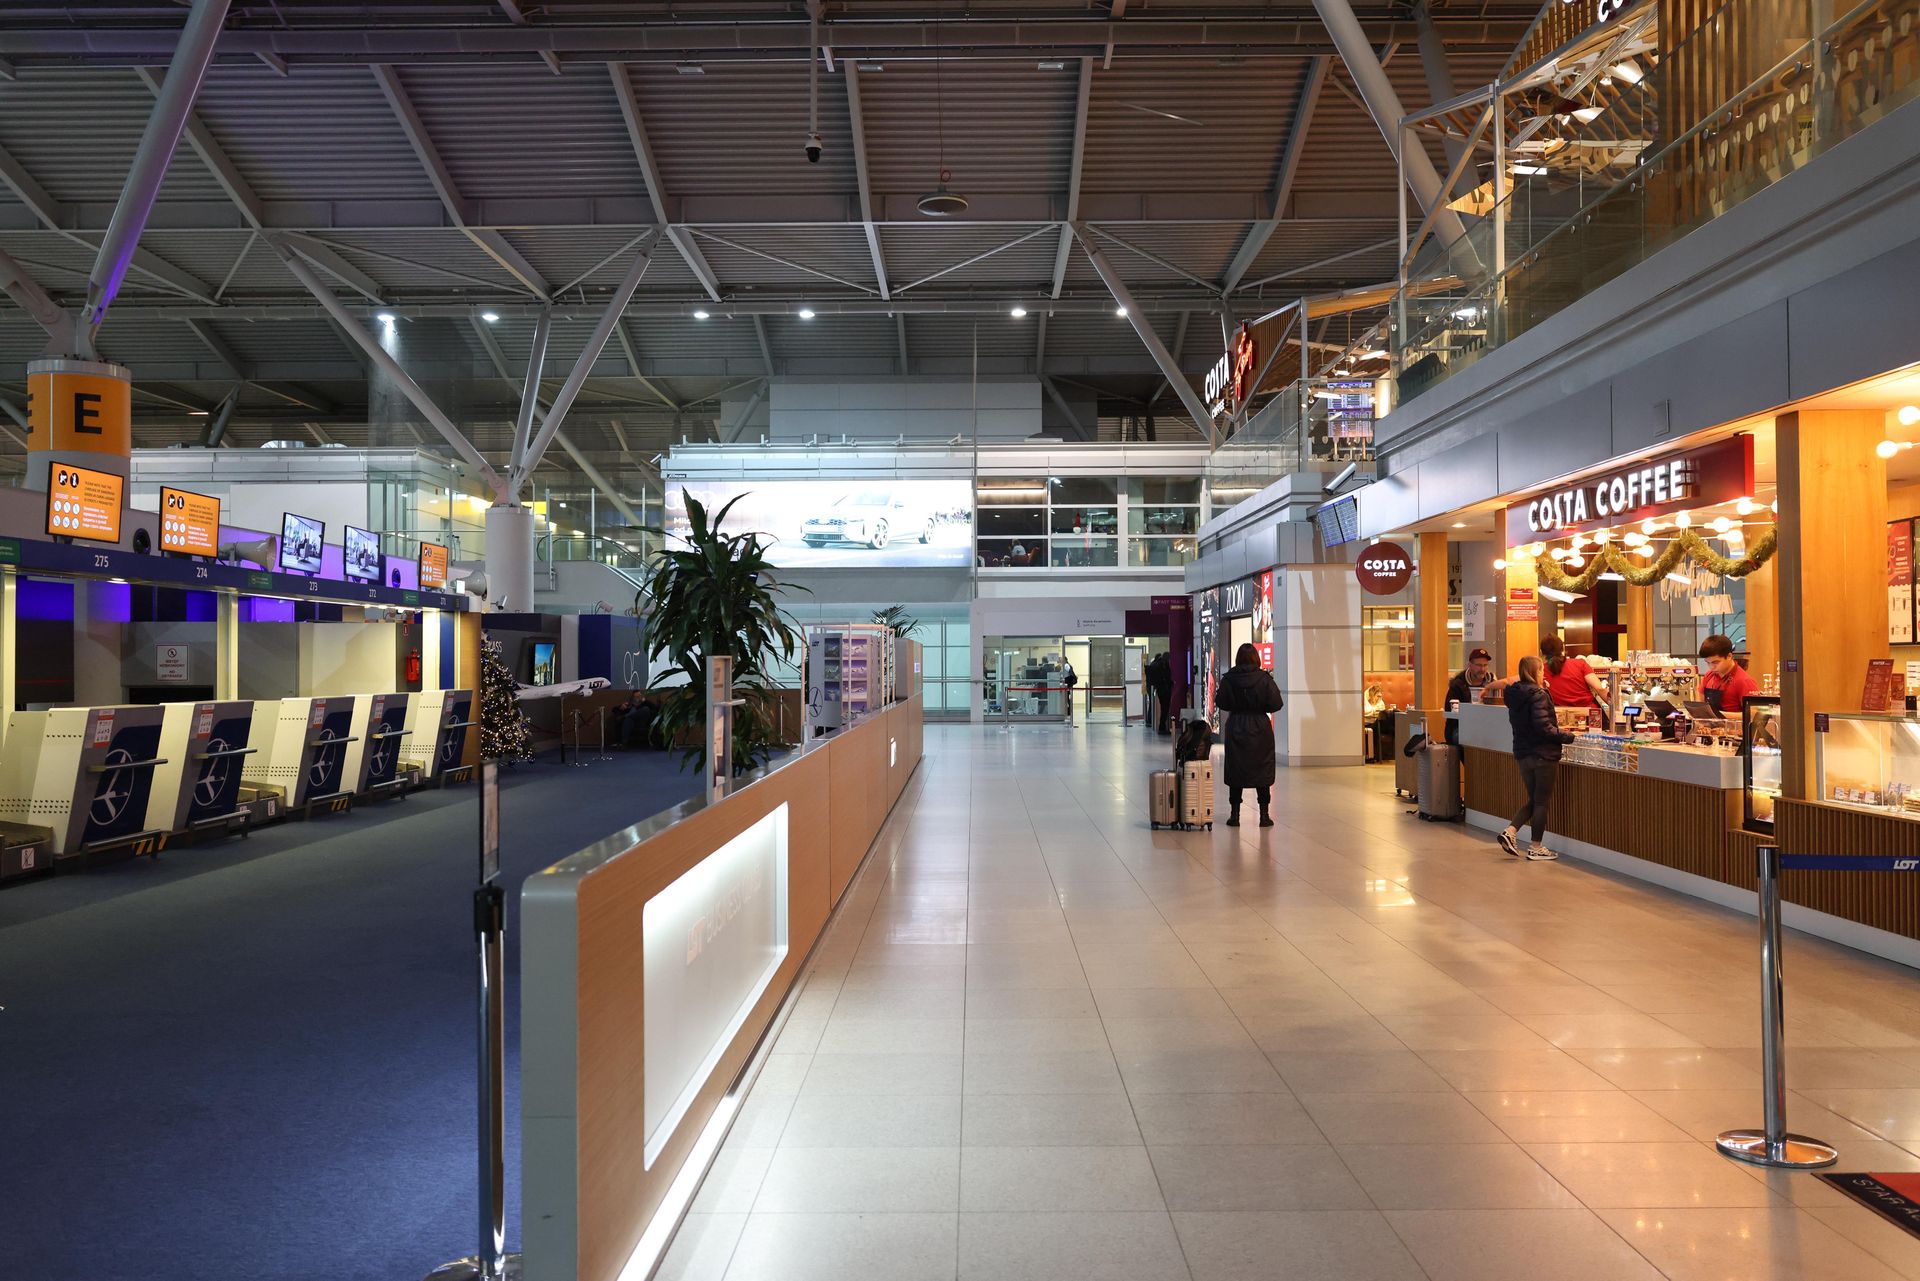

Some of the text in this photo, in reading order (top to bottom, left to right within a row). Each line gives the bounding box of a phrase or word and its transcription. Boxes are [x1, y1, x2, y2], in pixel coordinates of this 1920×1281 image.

[1205, 352, 1229, 404] COSTA
[75, 392, 102, 434] E
[1528, 460, 1685, 531] COSTA COFFEE
[95, 554, 109, 568] 275
[1363, 559, 1406, 571] COSTA
[196, 567, 208, 579] 274
[309, 581, 318, 591] 273
[1226, 583, 1245, 613] ZOOM
[588, 680, 604, 689] LOT
[1893, 859, 1920, 870] LOT
[1852, 1178, 1905, 1206] STAR
